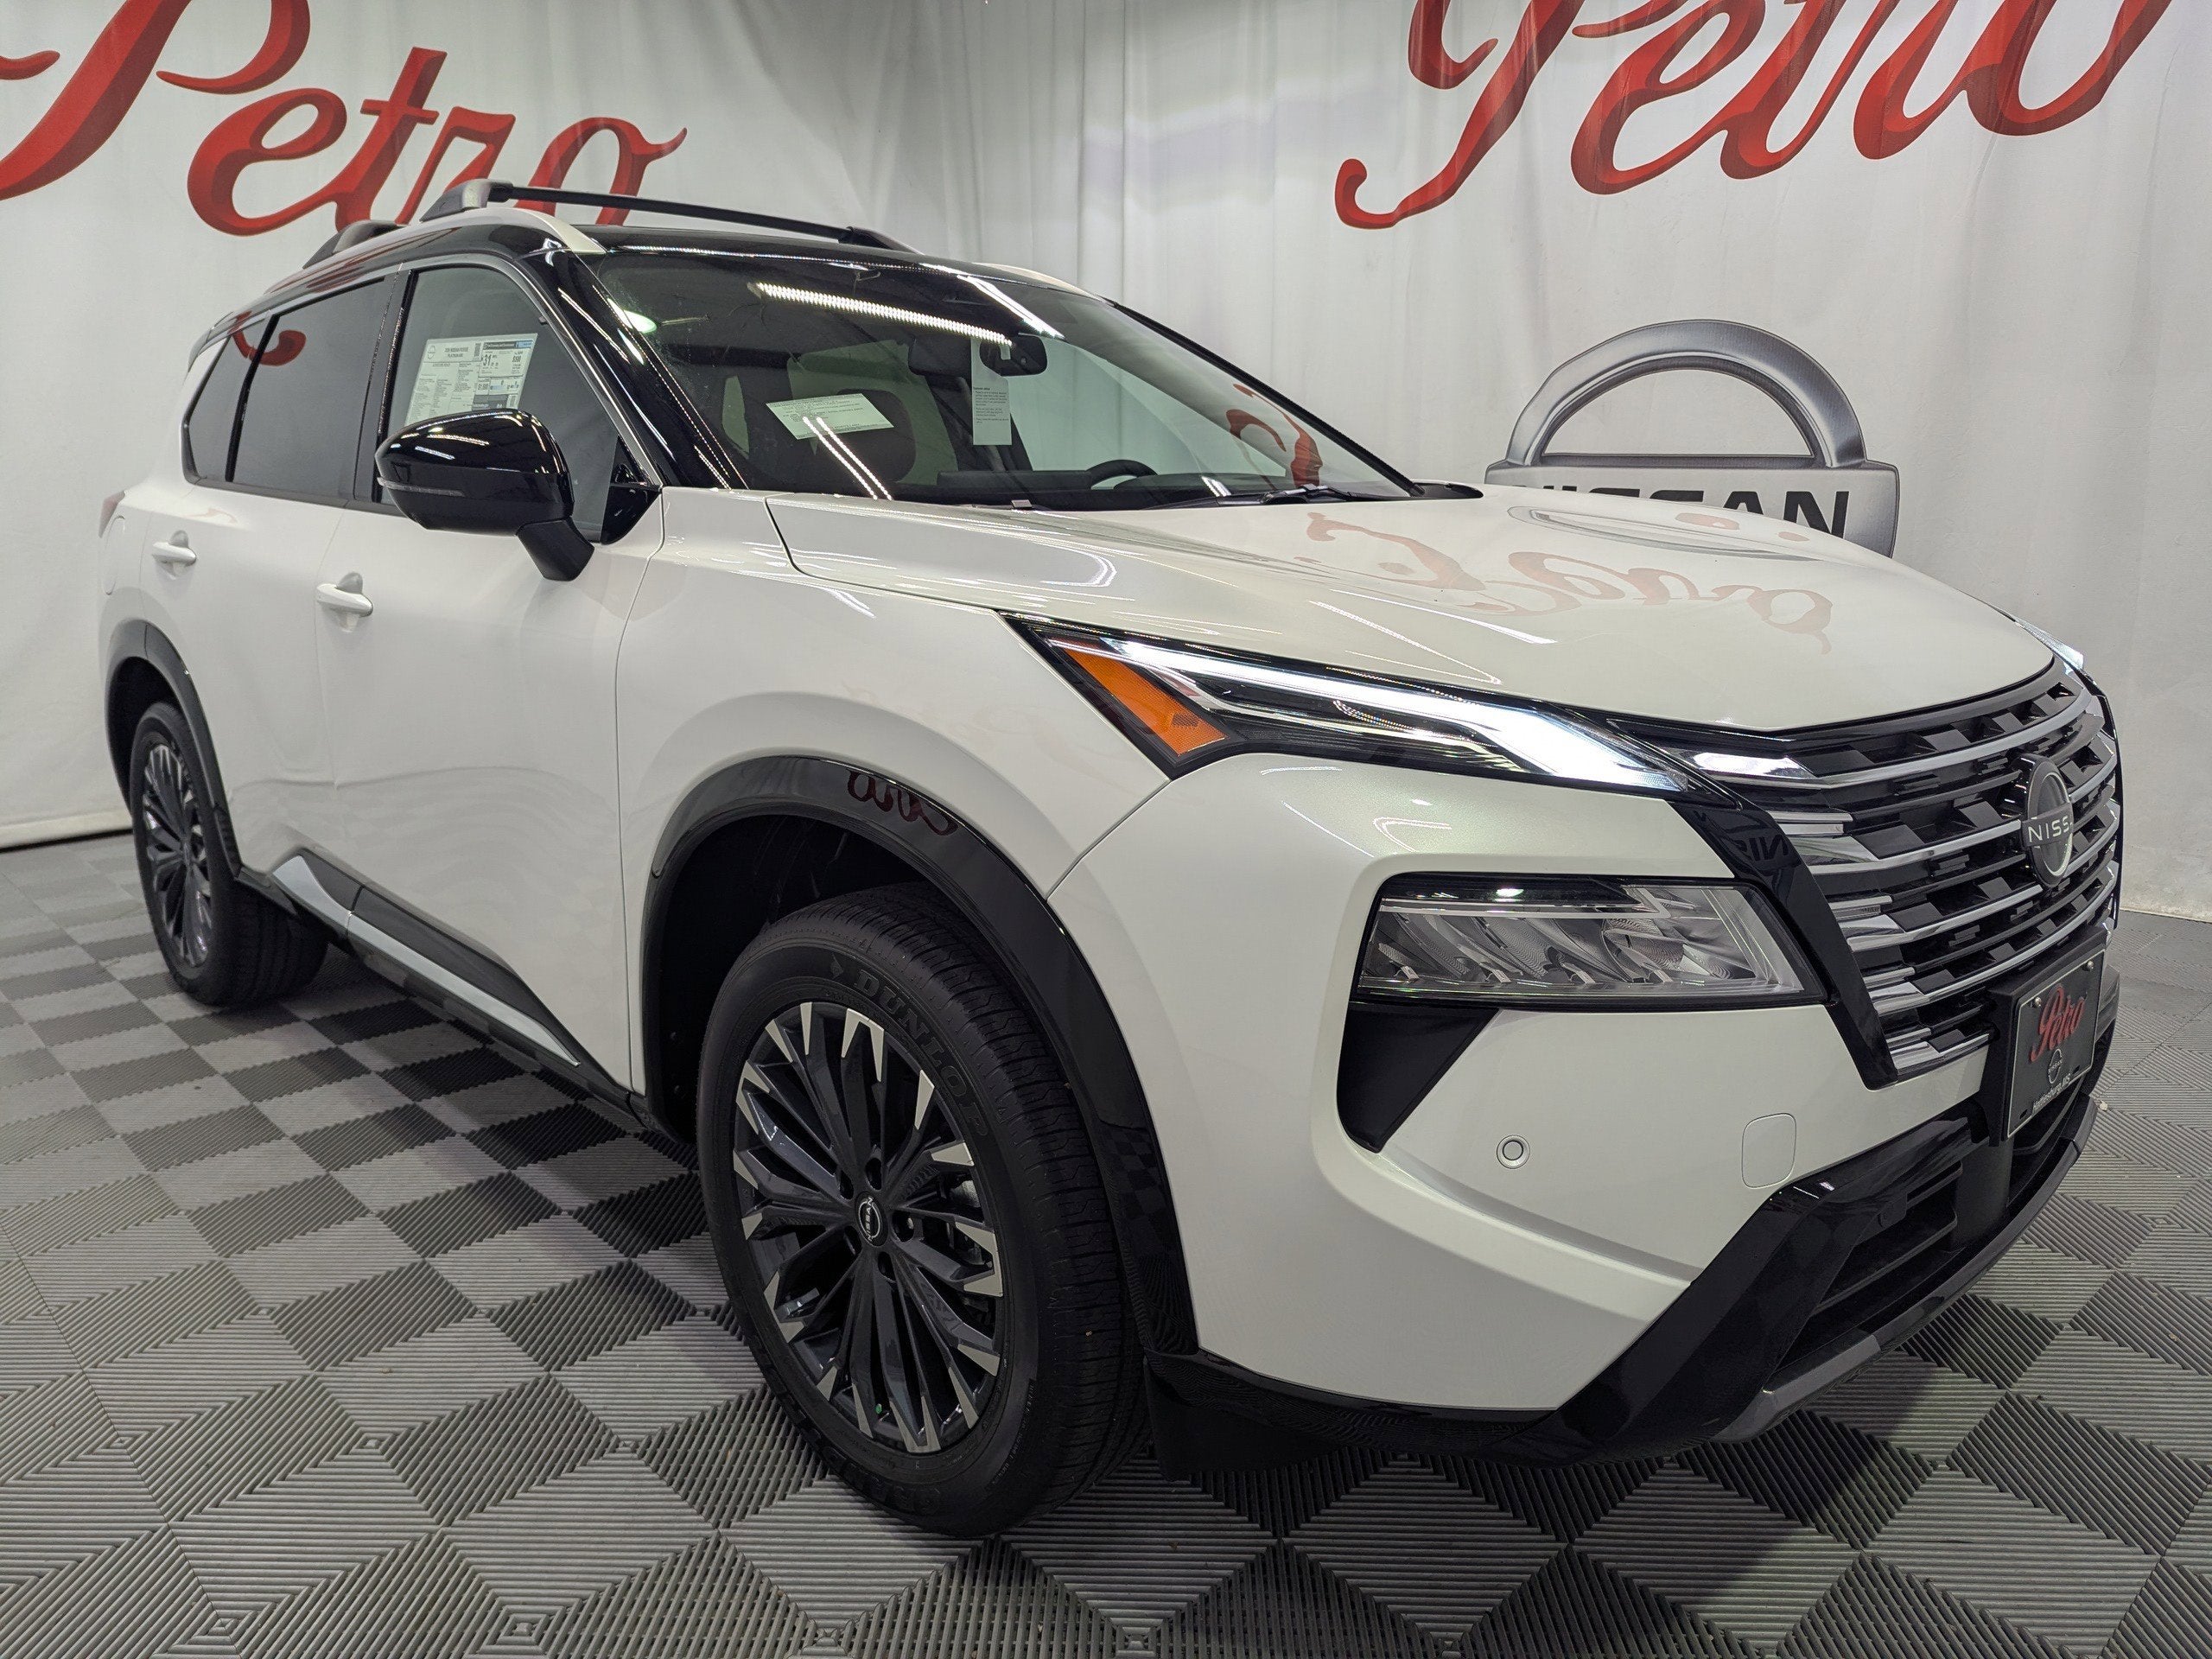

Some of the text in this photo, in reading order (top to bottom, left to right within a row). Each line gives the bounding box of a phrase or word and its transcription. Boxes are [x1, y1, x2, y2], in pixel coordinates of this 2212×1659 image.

[0, 0, 688, 236] Petro
[857, 969, 988, 1136] DUNLOP
[2030, 983, 2087, 1062] Petro
